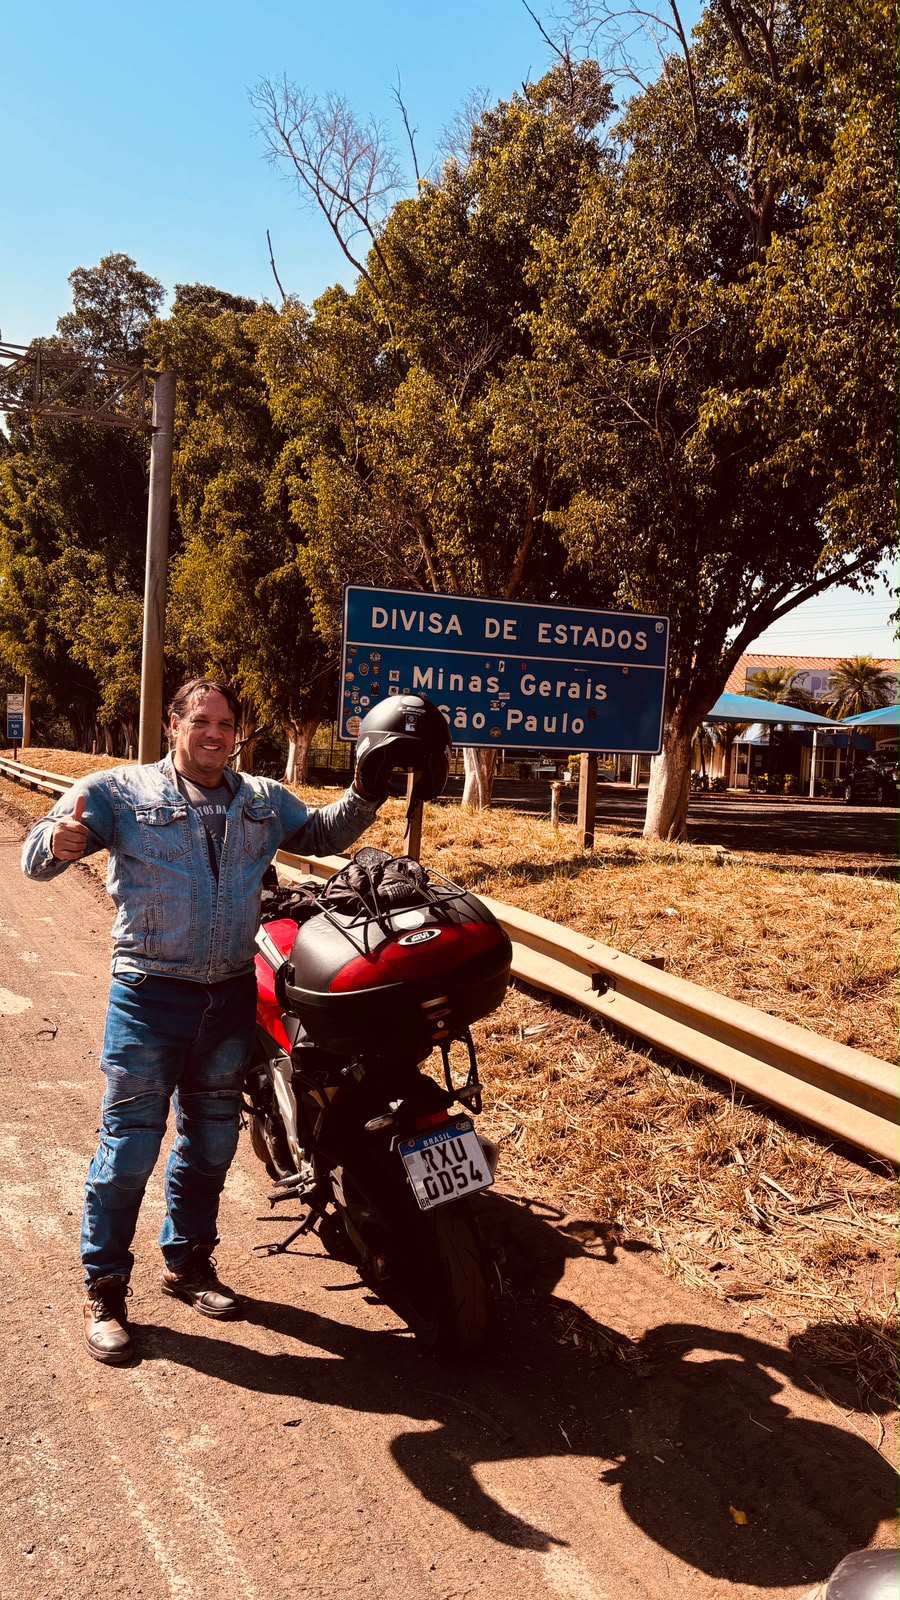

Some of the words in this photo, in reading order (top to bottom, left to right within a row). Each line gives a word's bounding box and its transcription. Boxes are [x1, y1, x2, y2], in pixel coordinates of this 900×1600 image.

[371, 606, 463, 636] DIVISA
[485, 617, 518, 641] DE
[537, 622, 648, 651] ESTADOS
[412, 665, 500, 694] Minas
[520, 674, 608, 701] Gerais
[438, 704, 486, 729] São
[506, 708, 585, 735] Paulo
[411, 931, 430, 941] GIVI
[420, 1138, 468, 1174] RXU
[423, 1132, 452, 1147] BRASIL
